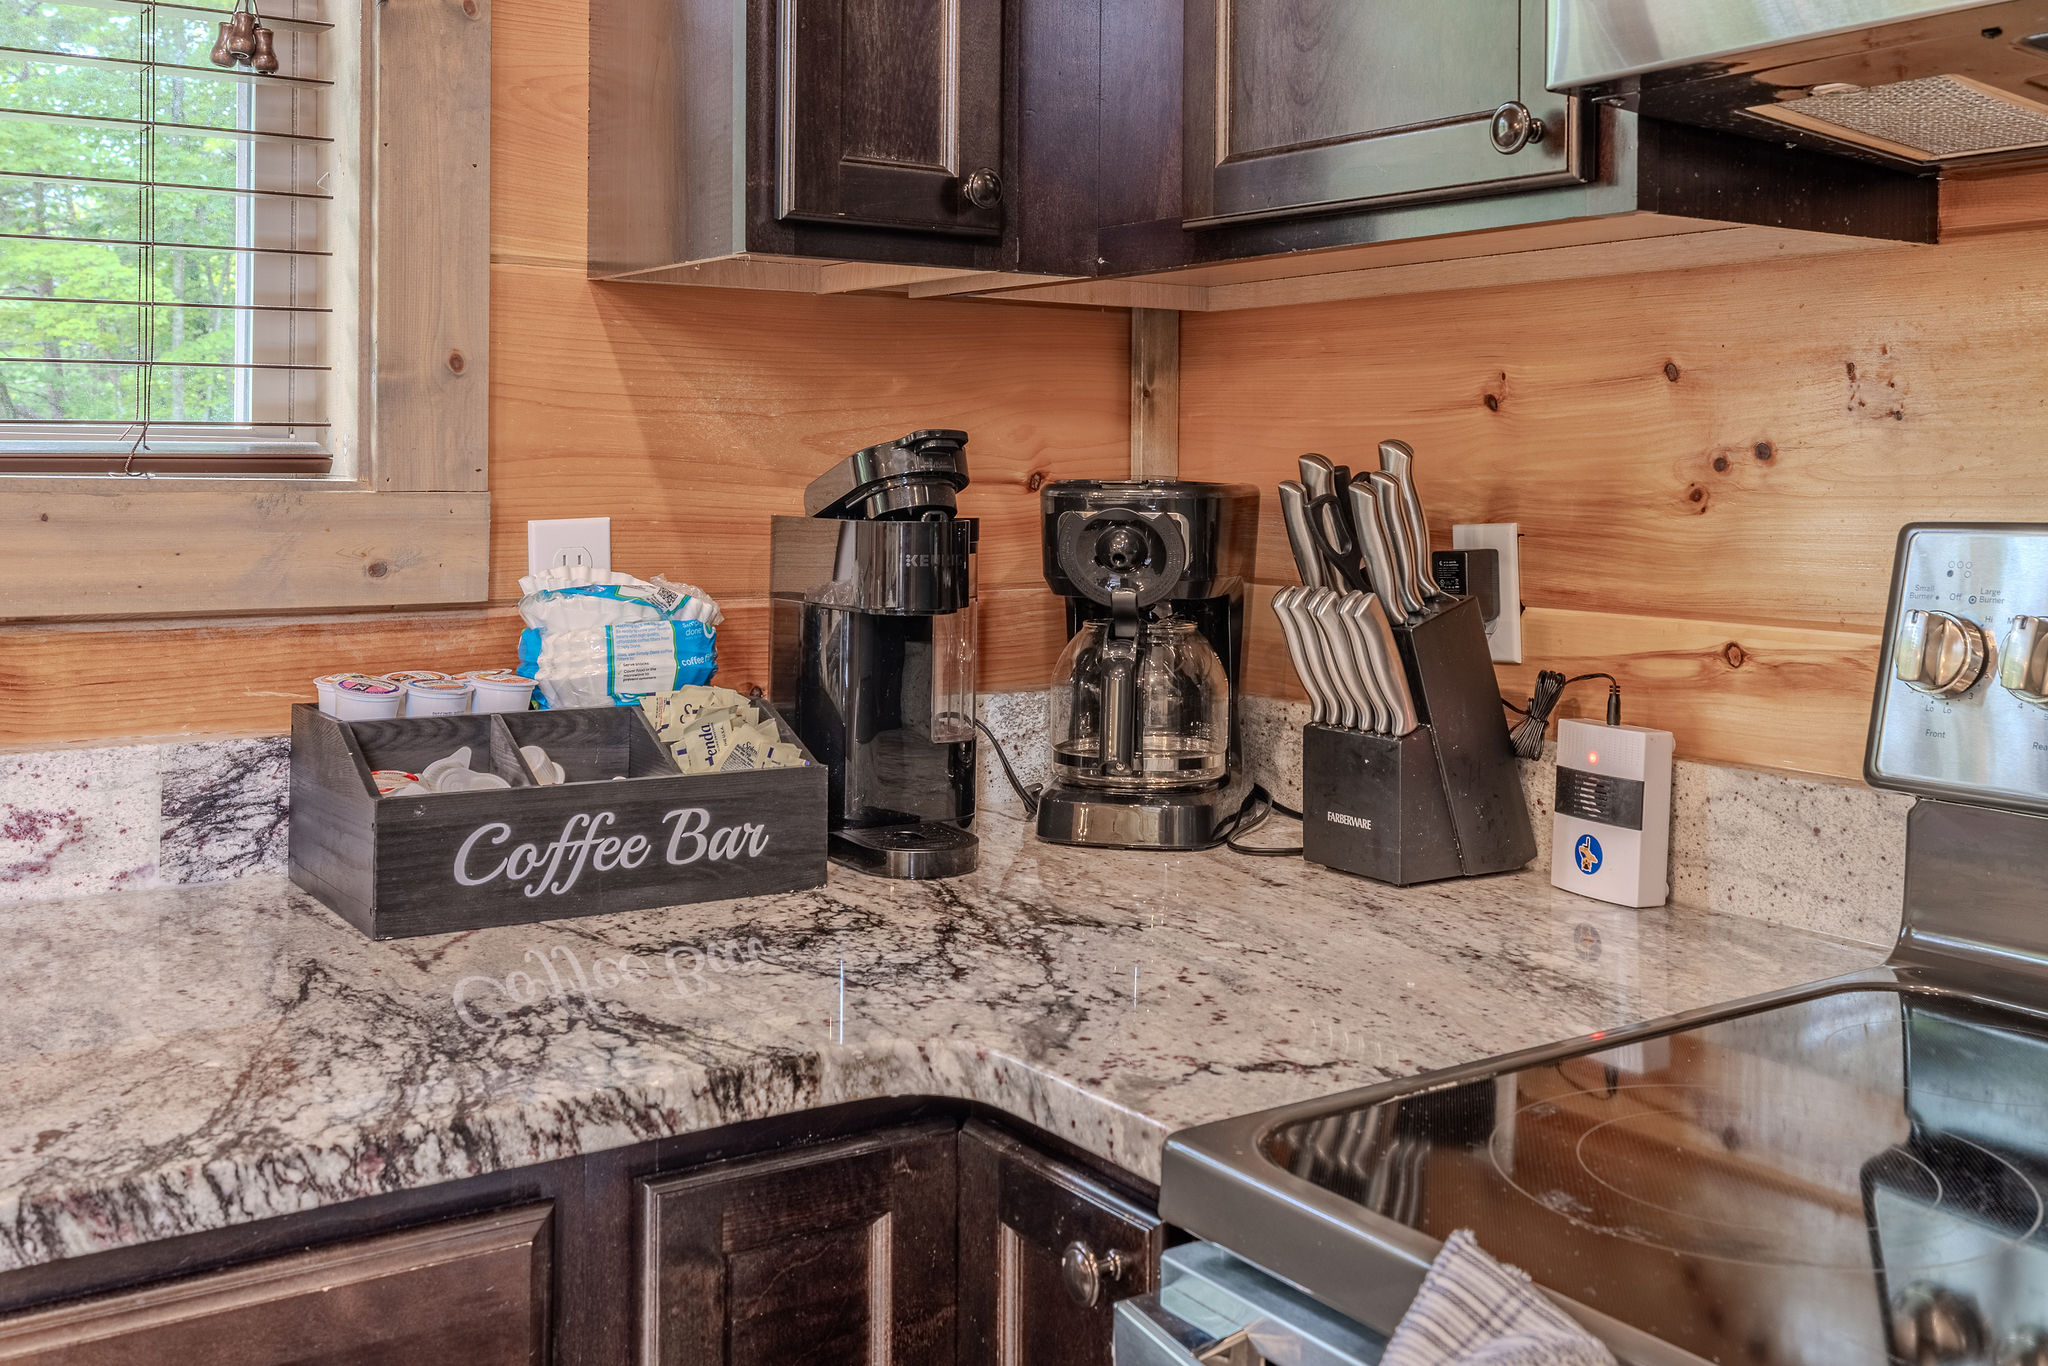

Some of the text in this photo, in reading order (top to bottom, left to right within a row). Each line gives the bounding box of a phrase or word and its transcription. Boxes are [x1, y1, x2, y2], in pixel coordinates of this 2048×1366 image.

[1914, 584, 1936, 593] Small
[1980, 588, 2001, 597] Large
[1909, 592, 1934, 600] Burner
[1949, 592, 1962, 601] Off
[1979, 596, 2005, 604] Burner
[681, 655, 705, 667] coffee
[1925, 728, 1946, 739] Front
[2032, 741, 2048, 752] Rea
[1327, 811, 1372, 830] FARBERWARE
[453, 808, 769, 898] Coffee Bar
